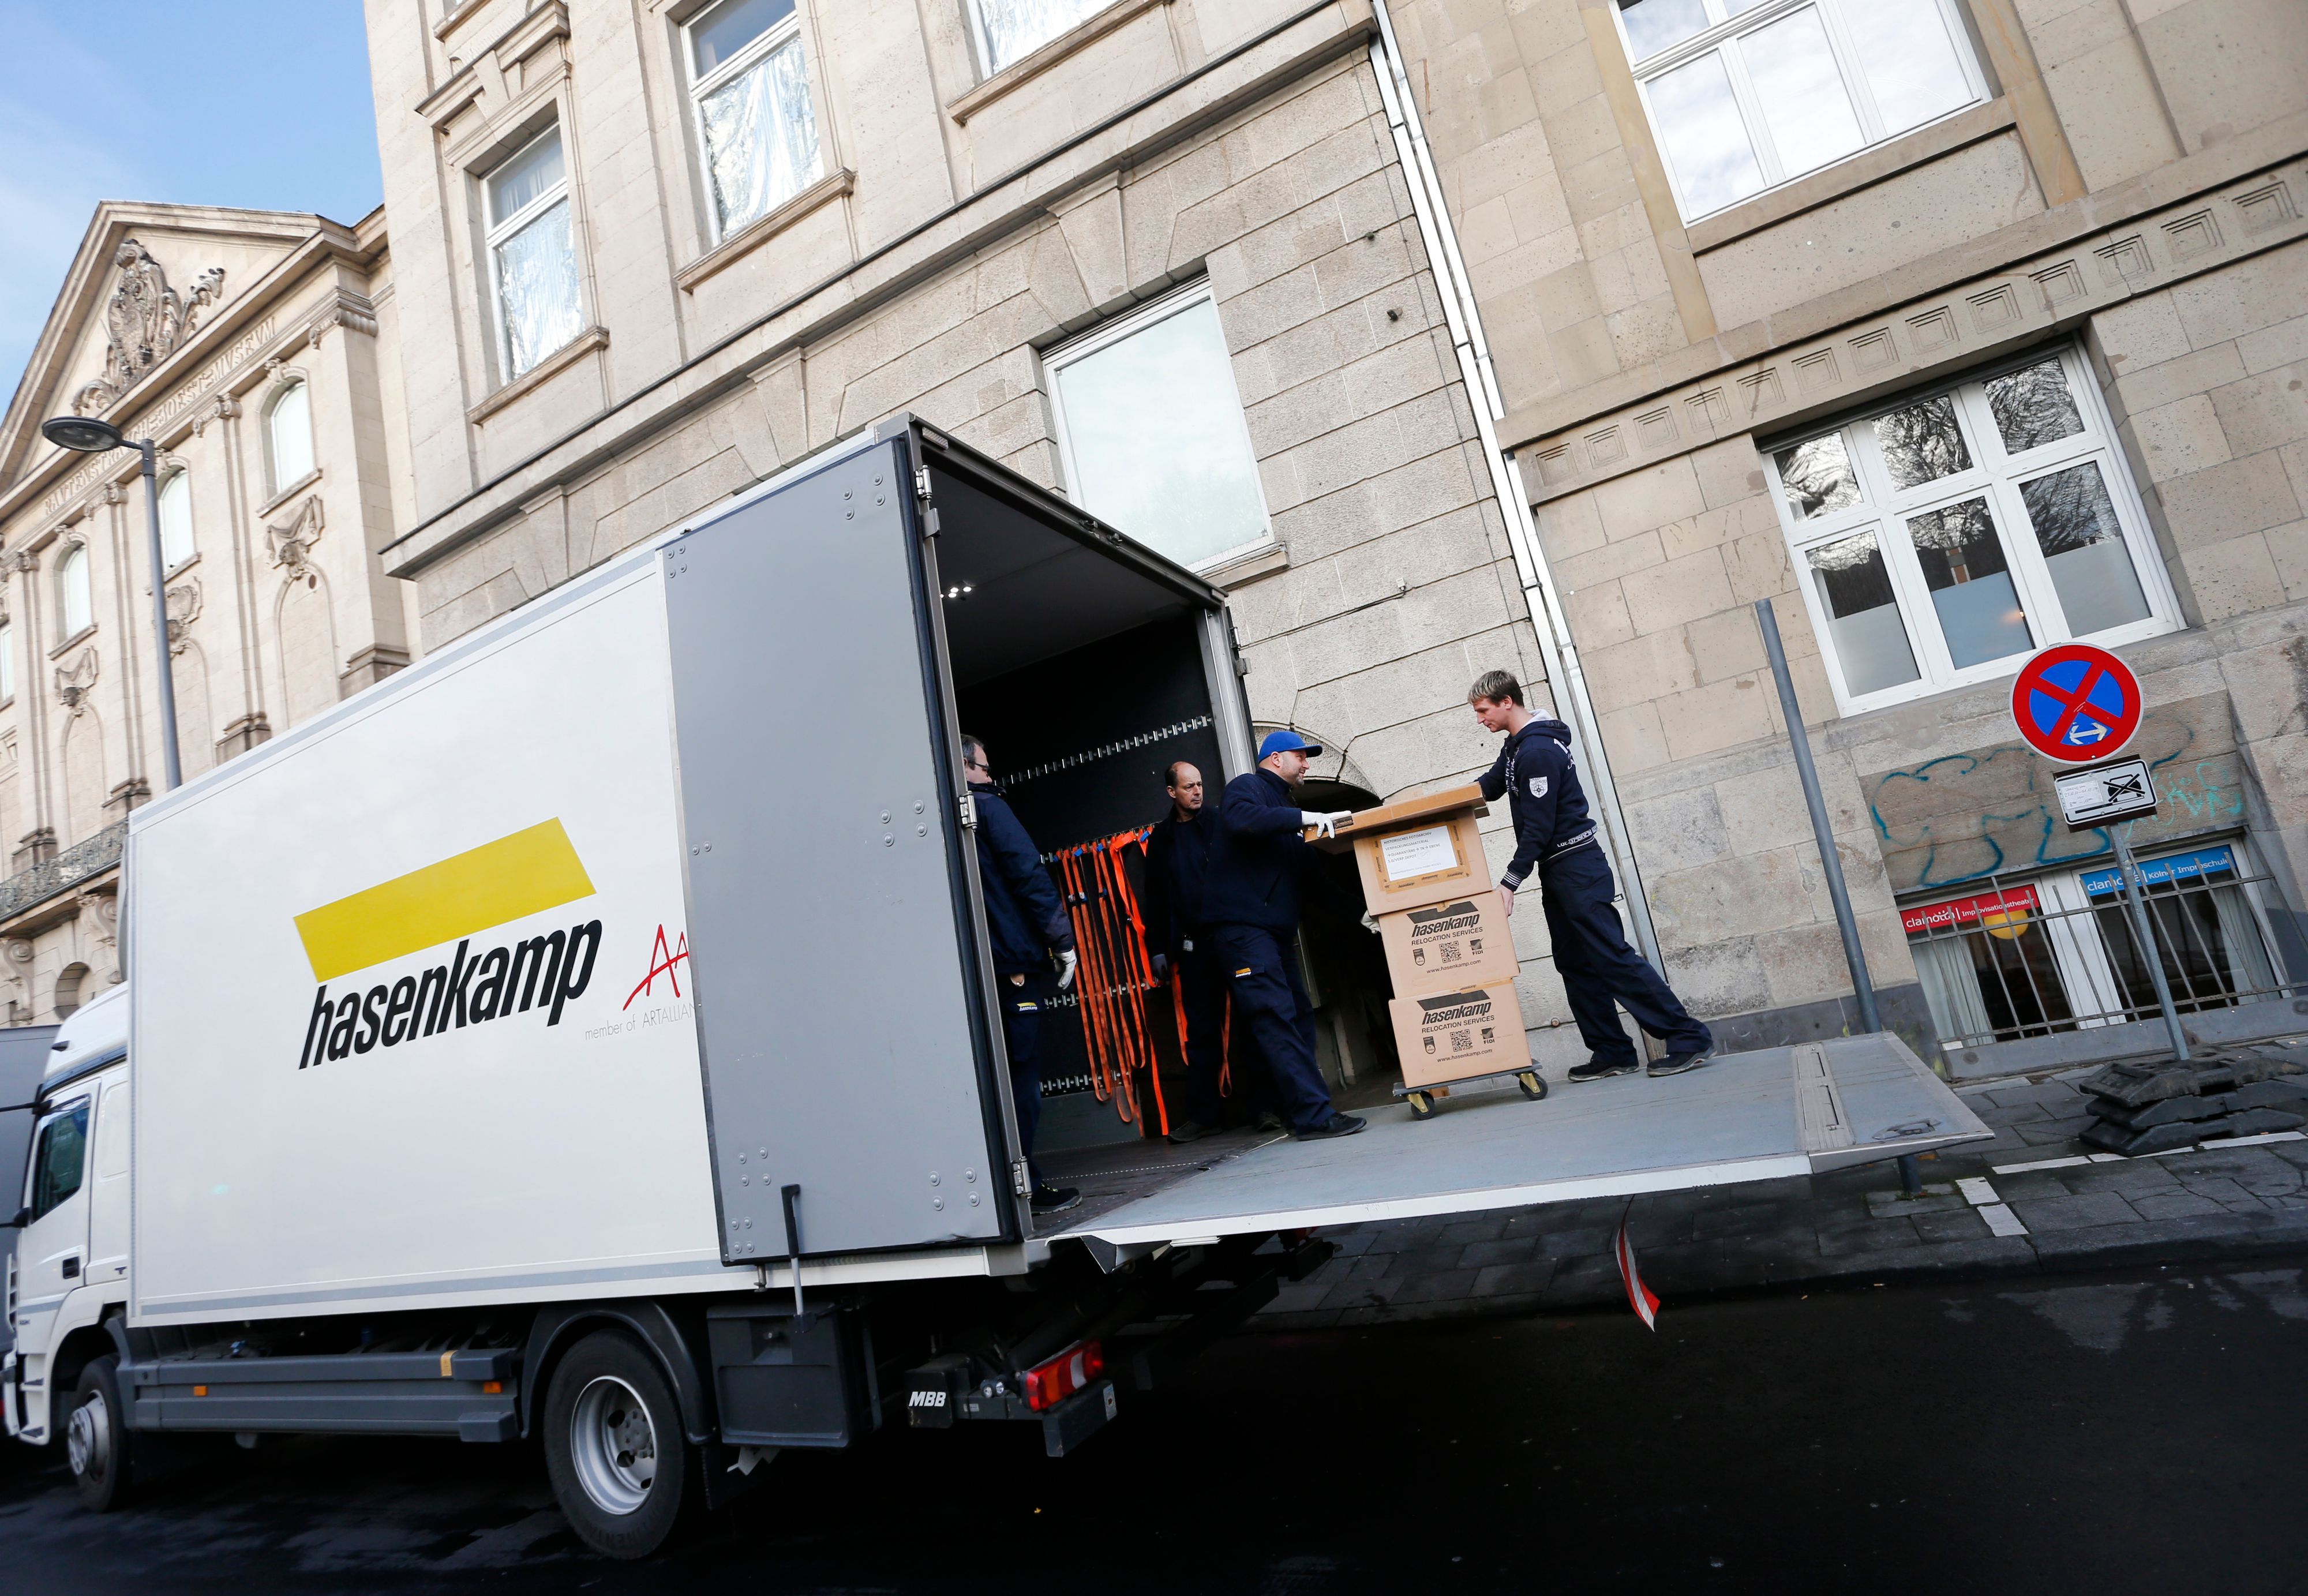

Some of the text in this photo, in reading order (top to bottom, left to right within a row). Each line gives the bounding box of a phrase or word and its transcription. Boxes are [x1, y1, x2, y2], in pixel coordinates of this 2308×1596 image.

[1384, 836, 1408, 845] HISTORISCHES
[1408, 831, 1432, 840] FOTOARCHIV
[1385, 840, 1429, 851] VERPACKUNGSMATERIAL
[1411, 914, 1480, 938] hasenkamp
[1411, 927, 1483, 946] RELOCATION SERVICES
[1427, 960, 1481, 974] www.hasenkamp.com
[298, 919, 602, 1069] hasenkamp
[1422, 1002, 1492, 1025] hasenkamp
[585, 1020, 623, 1040] member
[626, 1014, 636, 1031] of
[1422, 1015, 1495, 1033] RELOCATION SERVICES
[1437, 1049, 1493, 1062] www.hasenkamp.com
[909, 1391, 947, 1407] MBB
